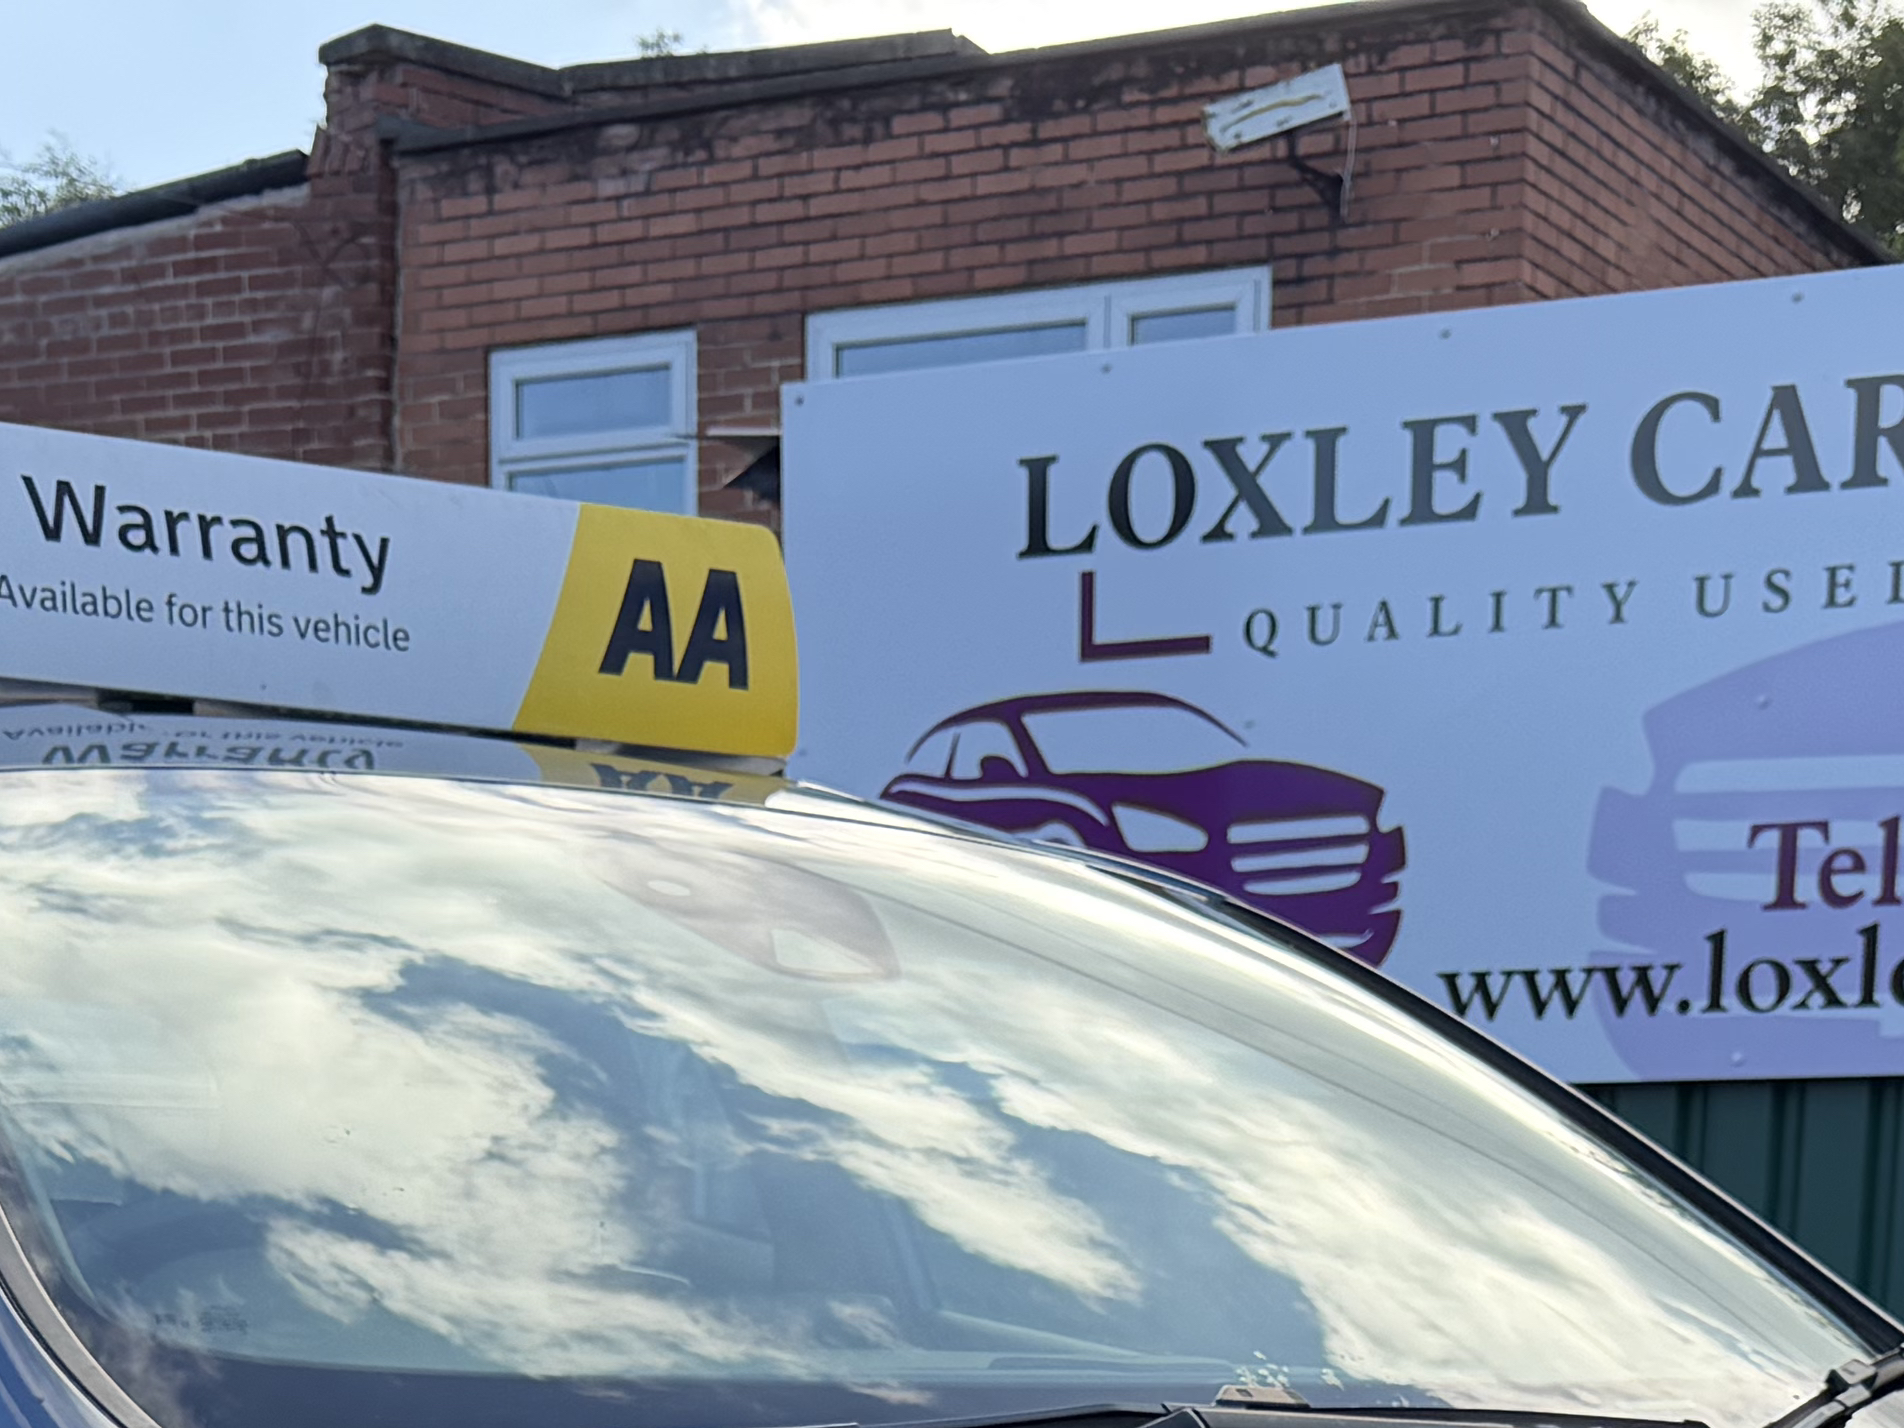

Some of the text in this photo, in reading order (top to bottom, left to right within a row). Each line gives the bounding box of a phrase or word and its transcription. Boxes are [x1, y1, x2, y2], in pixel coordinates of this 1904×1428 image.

[22, 474, 390, 596] Warranty
[1018, 404, 1587, 560] LOXLEY
[165, 593, 213, 629] for
[222, 600, 284, 638] this
[293, 612, 411, 652] vehicle
[597, 558, 748, 690] AA
[1242, 580, 1636, 659] QUALITY
